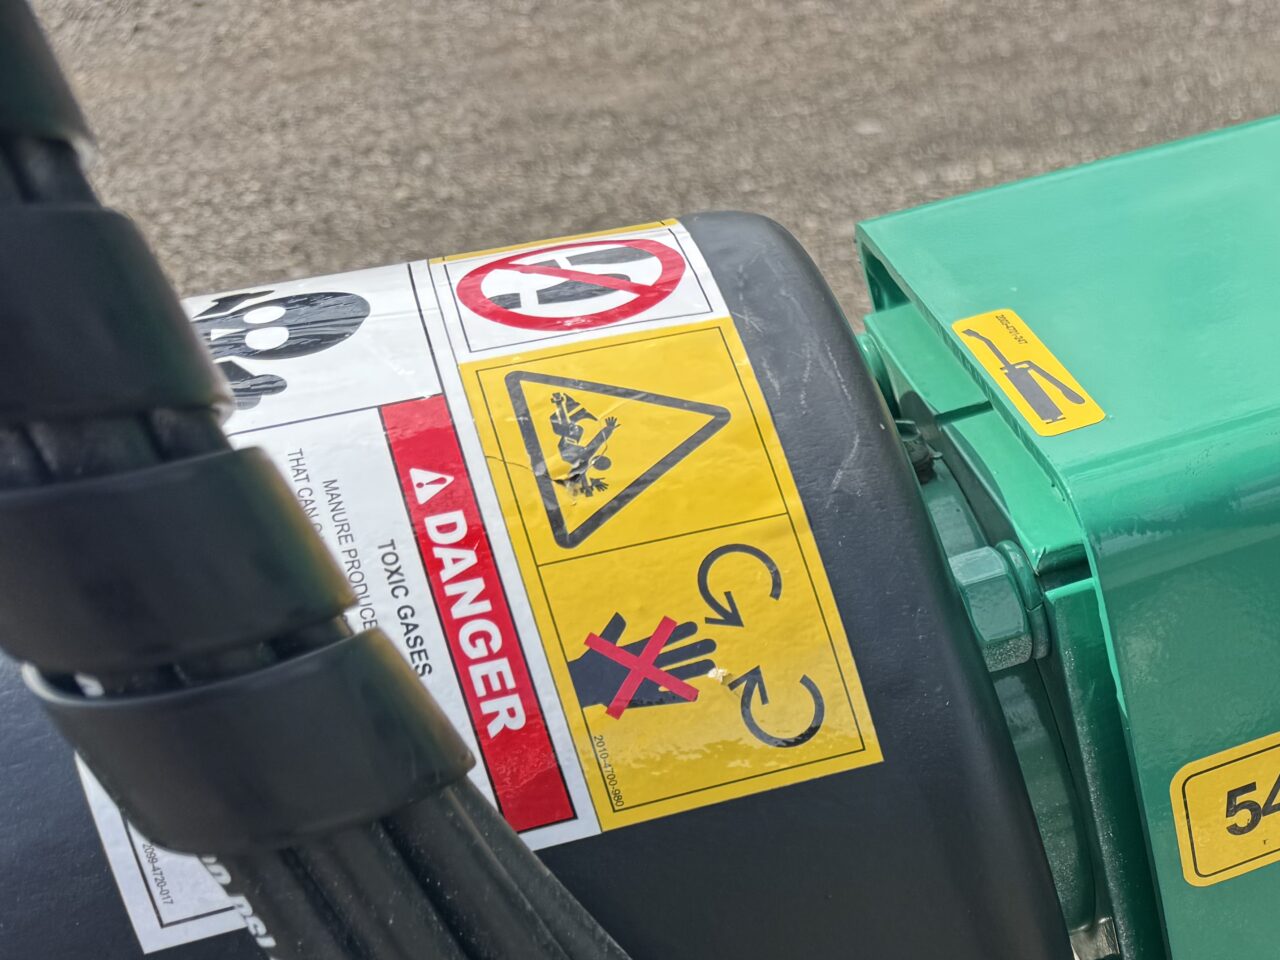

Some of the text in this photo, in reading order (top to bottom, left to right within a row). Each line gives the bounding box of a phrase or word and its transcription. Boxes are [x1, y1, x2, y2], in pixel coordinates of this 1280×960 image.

[287, 448, 311, 484] THAT
[322, 478, 355, 545] MANURE
[377, 539, 433, 678] TOXIC GASES
[423, 508, 527, 740] DANGER
[593, 733, 625, 808] 2010-4700-980
[142, 842, 174, 906] 2099-4720-017
